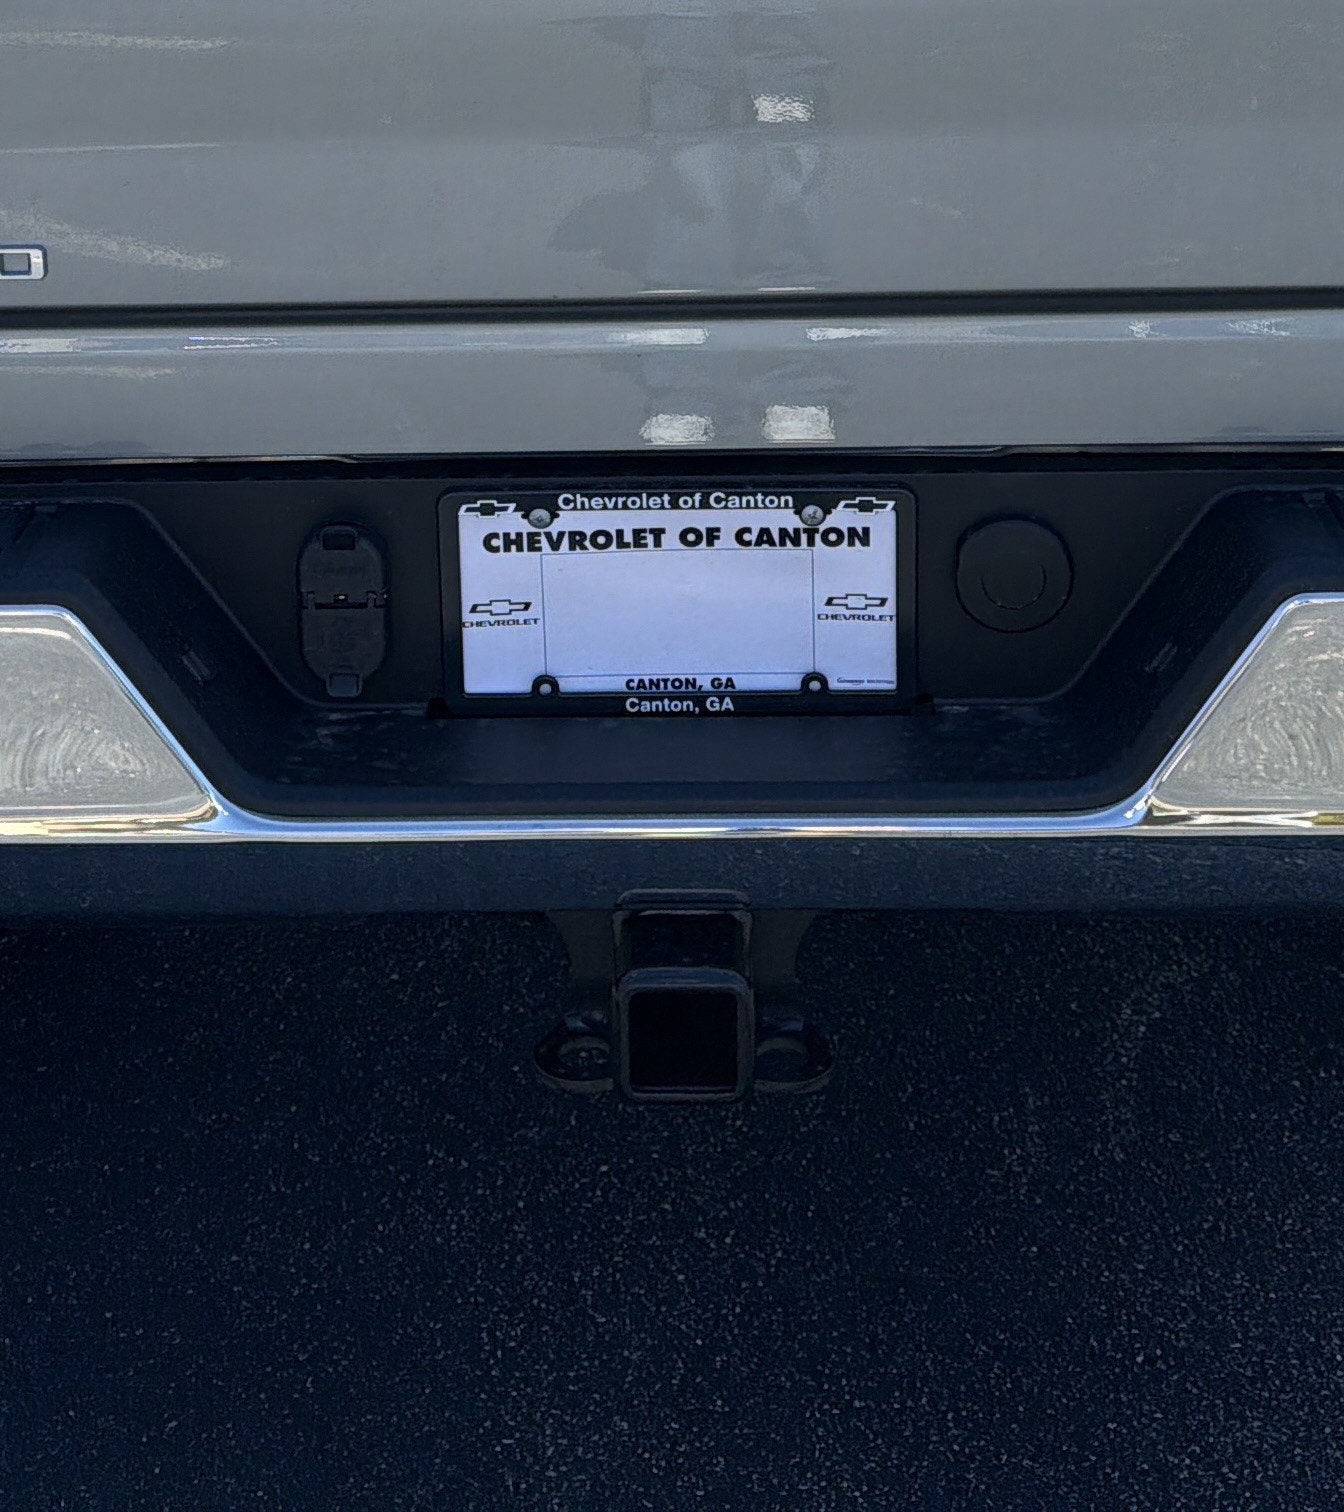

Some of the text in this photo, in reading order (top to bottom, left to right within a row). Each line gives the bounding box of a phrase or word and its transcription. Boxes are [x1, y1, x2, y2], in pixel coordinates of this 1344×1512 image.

[557, 491, 794, 510] Chevrolet of Canton
[482, 526, 871, 553] CHEVROLET OF CANTON
[462, 618, 540, 628] CHEVROLET
[817, 613, 895, 622] CHEVROLET
[625, 677, 736, 692] CANTON, GA
[625, 696, 735, 714] Canton, GA
